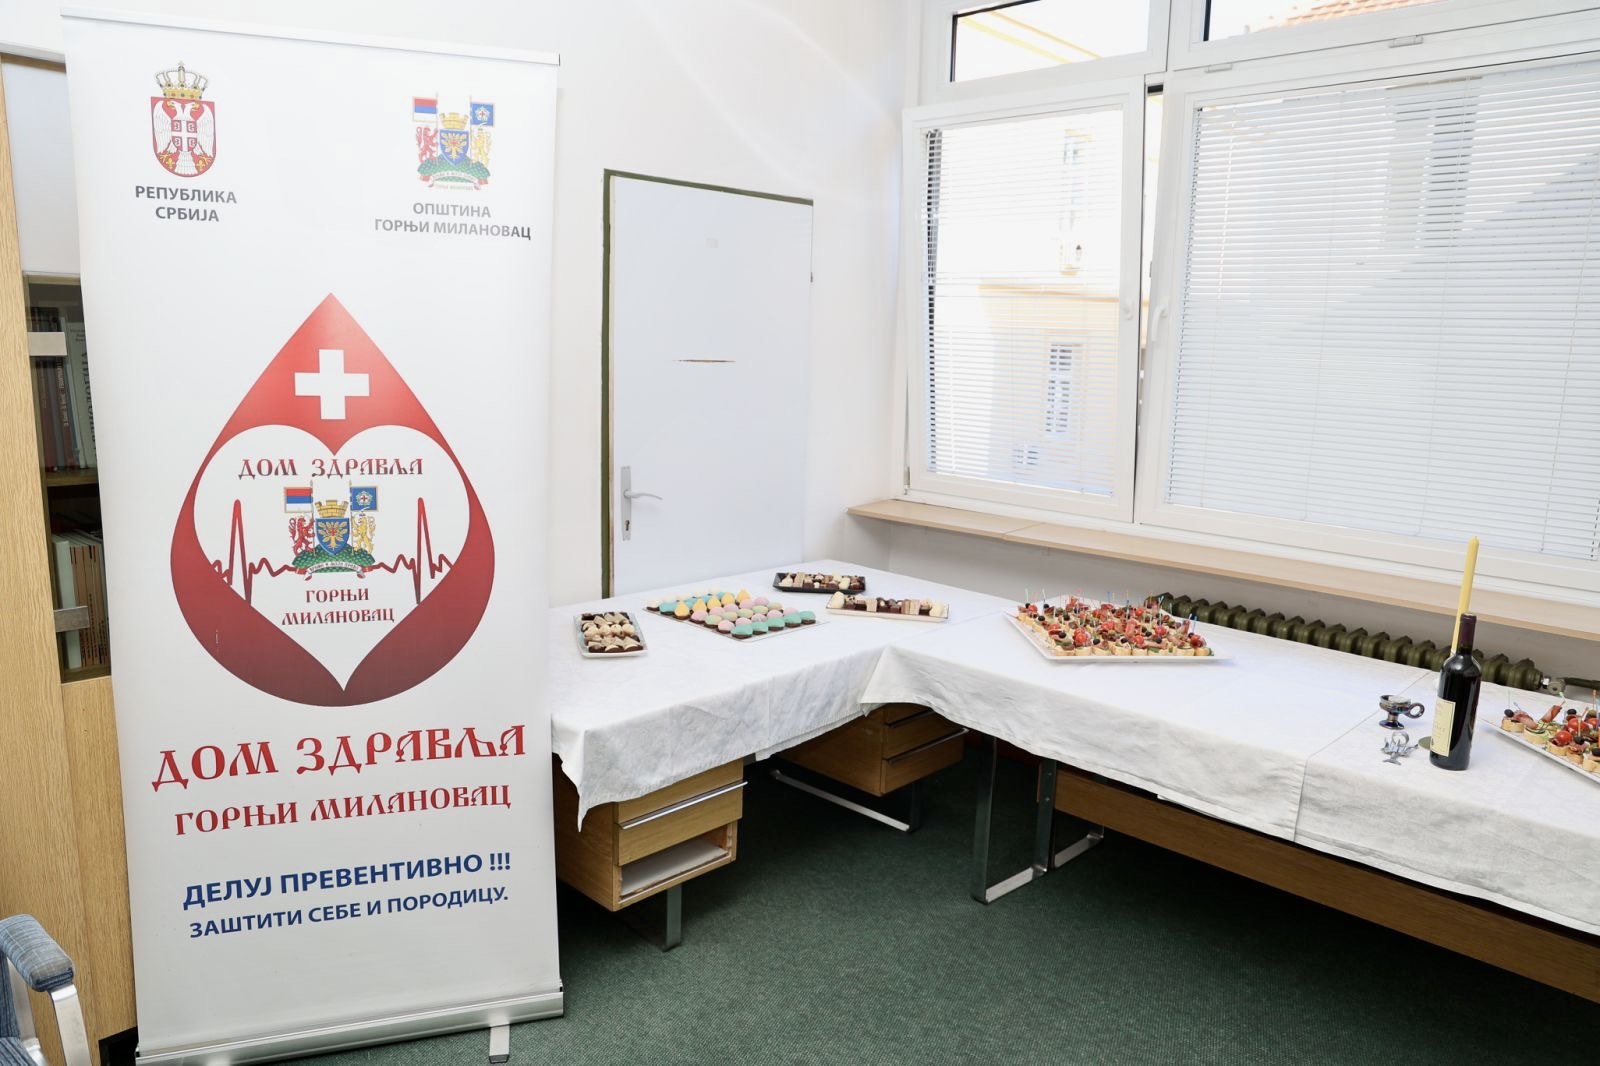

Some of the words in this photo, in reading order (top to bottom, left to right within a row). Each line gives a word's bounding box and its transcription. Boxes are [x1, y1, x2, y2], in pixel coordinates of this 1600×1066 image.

[135, 185, 237, 204] РЕПУБЛИКА
[155, 206, 220, 222] СРБИЈА
[412, 202, 492, 218] ОПШТИНА
[374, 218, 430, 233] ГОРЊИ
[433, 221, 532, 240] МИЛАНОВАЦ
[237, 458, 299, 481] ДОМ
[311, 458, 423, 480] ЗДРАВЉА
[305, 587, 369, 604] ГОРЊИ
[280, 607, 396, 627] МИЛАНОВАЦ
[151, 741, 279, 793] ДОМ
[296, 724, 526, 776] ЗДРАВЉА
[174, 801, 299, 836] ГОРЊИ
[310, 784, 512, 822] МИЛАНОВАЦ
[182, 876, 272, 911] ДЕЛУЈ
[280, 854, 483, 894] ПРЕВЕНТИВНО
[489, 852, 511, 872] !!!
[189, 909, 303, 939] ЗАШТИТИ
[308, 902, 362, 923] СЕБЕ
[366, 899, 382, 916] И
[387, 886, 509, 914] ПОРОДИЦУ.
